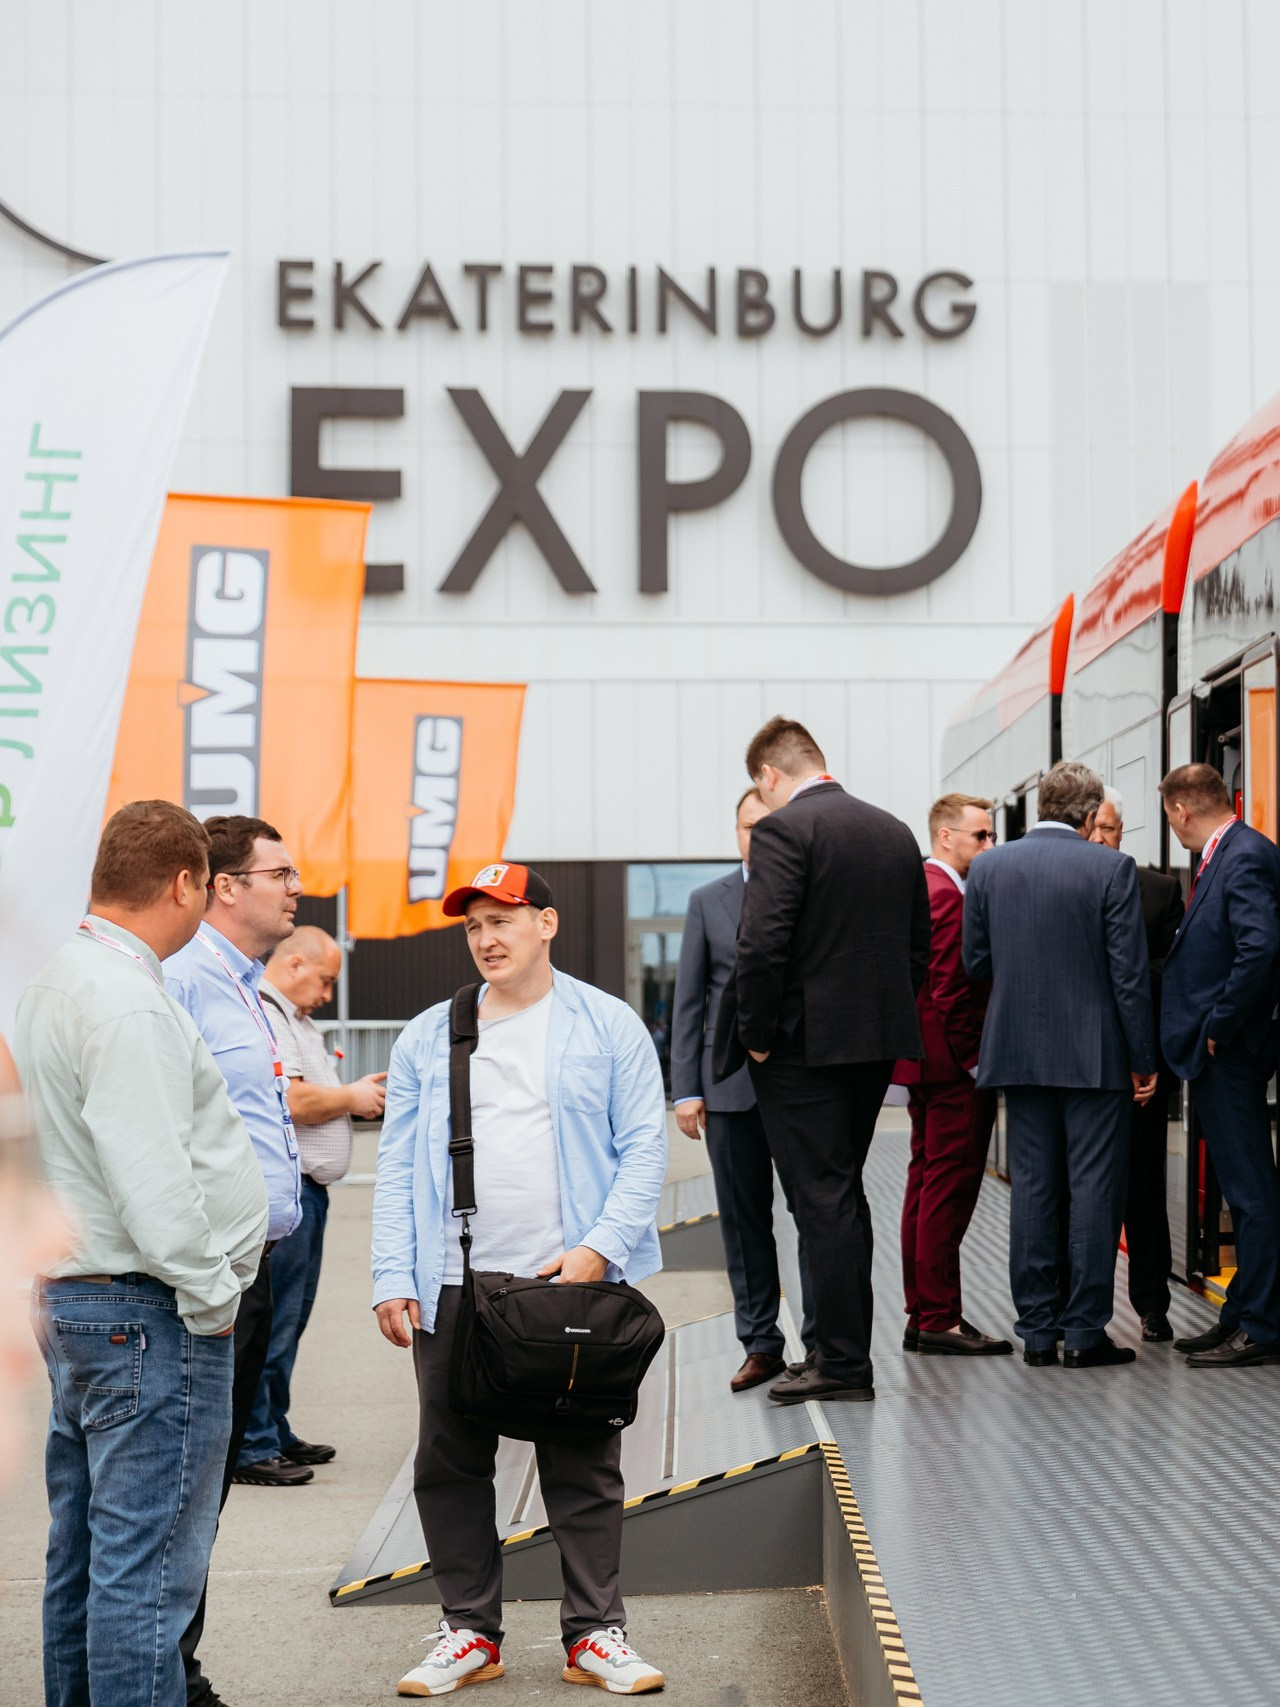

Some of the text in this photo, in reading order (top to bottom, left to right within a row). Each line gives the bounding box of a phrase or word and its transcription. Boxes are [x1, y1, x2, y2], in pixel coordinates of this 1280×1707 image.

[277, 259, 978, 340] EKATERINBURG
[289, 385, 982, 597] EXPO
[188, 550, 265, 826] UMG
[407, 717, 462, 900] UMG
